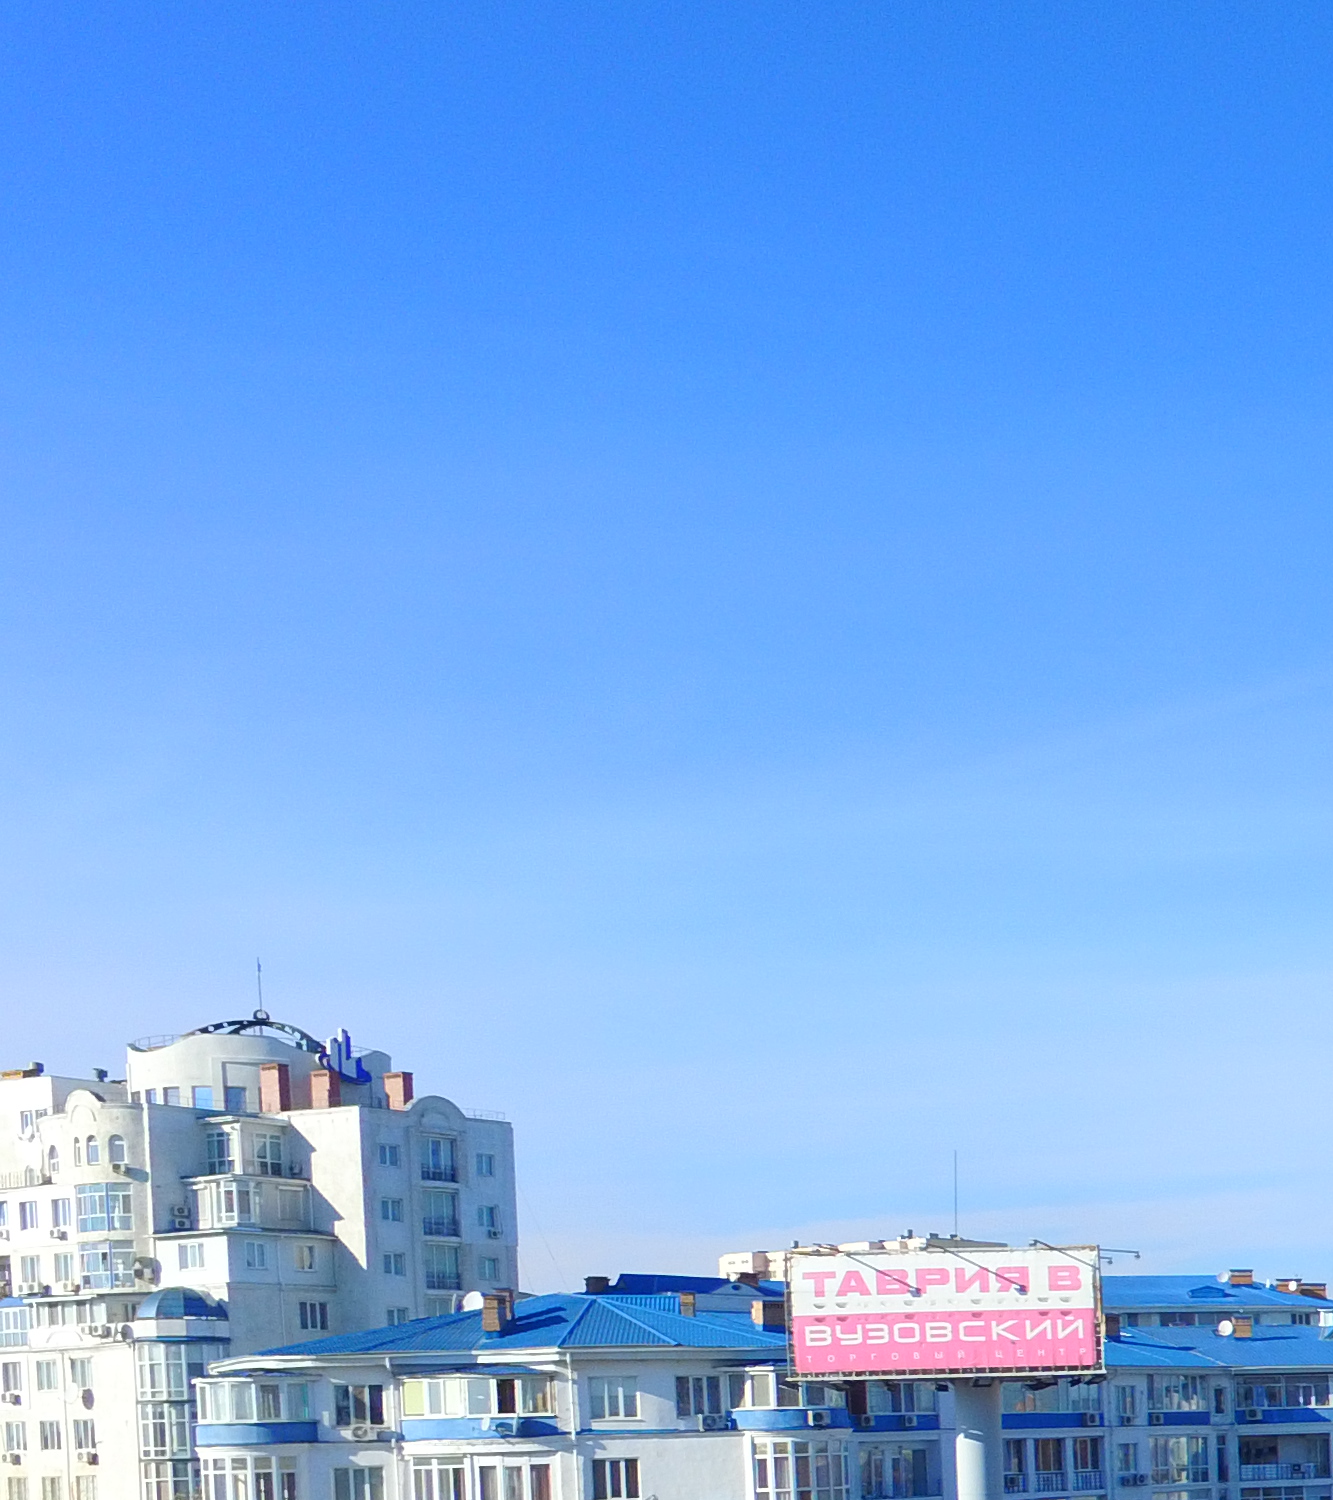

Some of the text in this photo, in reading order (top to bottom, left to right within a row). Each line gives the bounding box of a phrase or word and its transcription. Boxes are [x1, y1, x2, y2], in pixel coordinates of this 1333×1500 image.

[802, 1264, 1082, 1298] ТАВРИЯ В
[804, 1315, 1085, 1348] ВУЗОВСКИЙ
[806, 1346, 1088, 1365] ТОРГОВЫЙ ЦЕНТР
